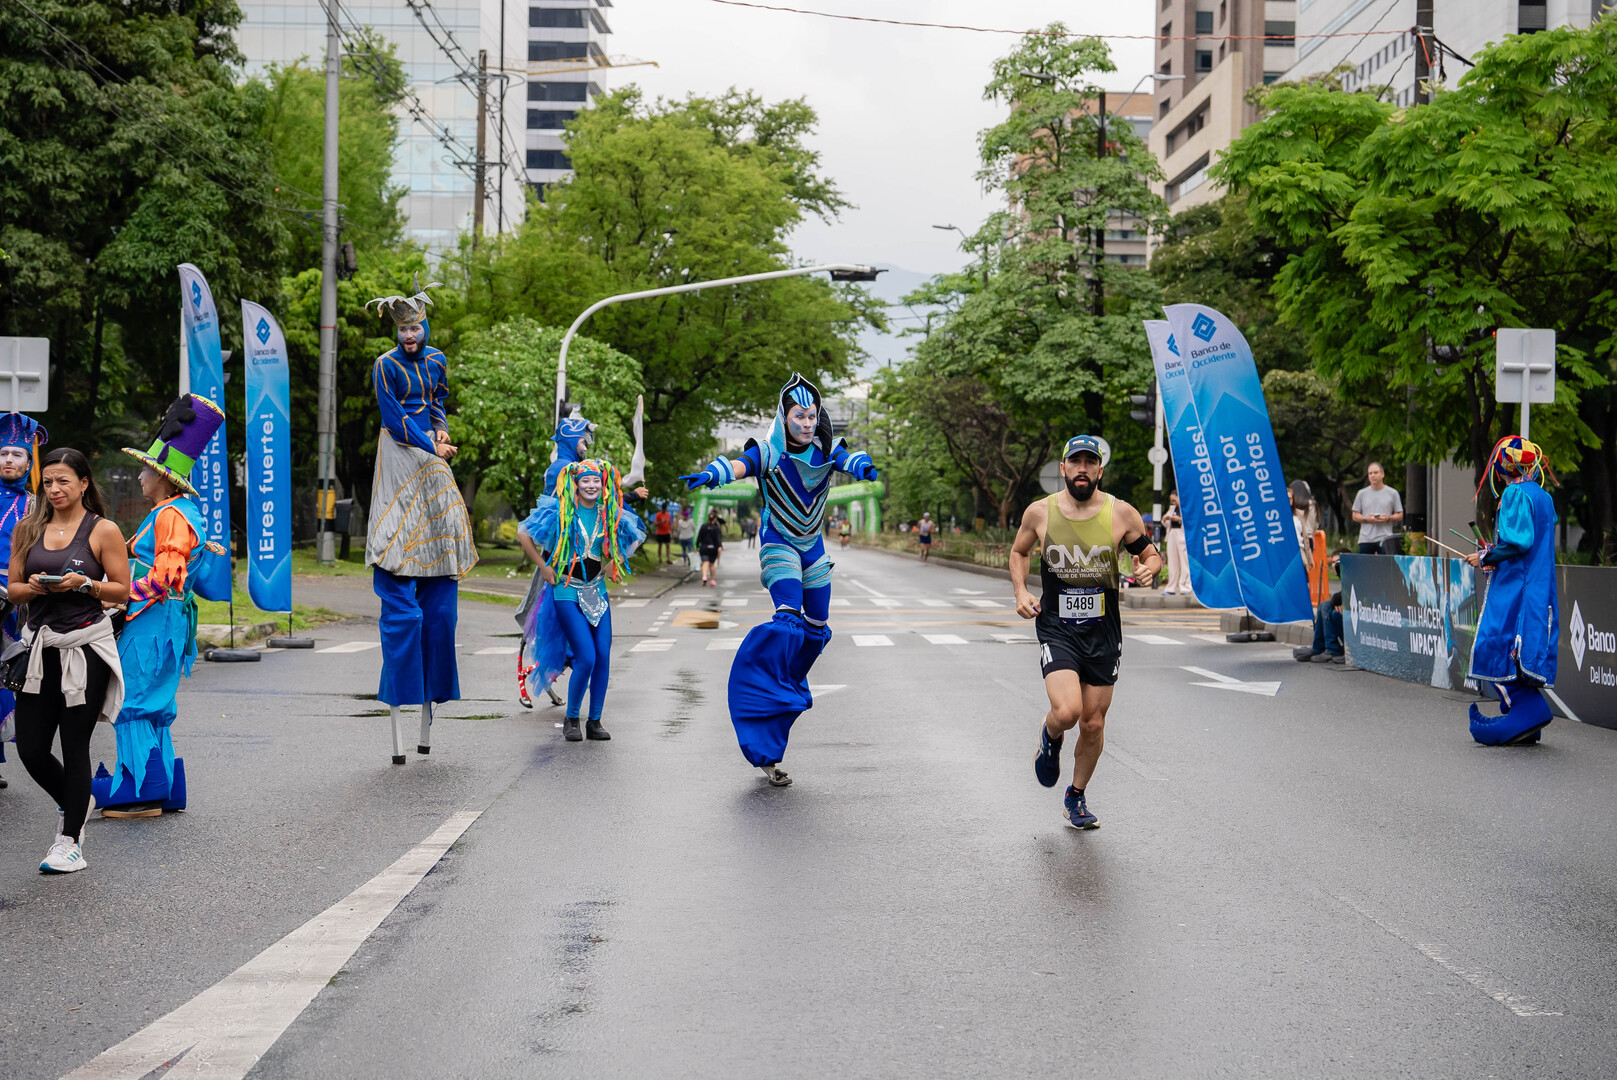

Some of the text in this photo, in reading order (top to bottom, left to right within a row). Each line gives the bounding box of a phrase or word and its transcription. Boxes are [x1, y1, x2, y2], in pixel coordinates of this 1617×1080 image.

[1191, 342, 1231, 358] Banco de
[1191, 352, 1237, 369] Occidente
[1164, 361, 1183, 370] Banc
[1165, 368, 1185, 380] Occid
[212, 460, 224, 502] que
[259, 412, 275, 561] ¡Eres fuerte!
[1185, 425, 1223, 557] ¡Tú puedes!
[1245, 432, 1285, 545] tus metas
[1219, 434, 1261, 561] Unidos por
[210, 508, 223, 540] los
[1066, 596, 1094, 610] 5489
[1407, 605, 1417, 627] TU
[1587, 622, 1616, 654] Banco
[1590, 665, 1616, 687] Del lado
